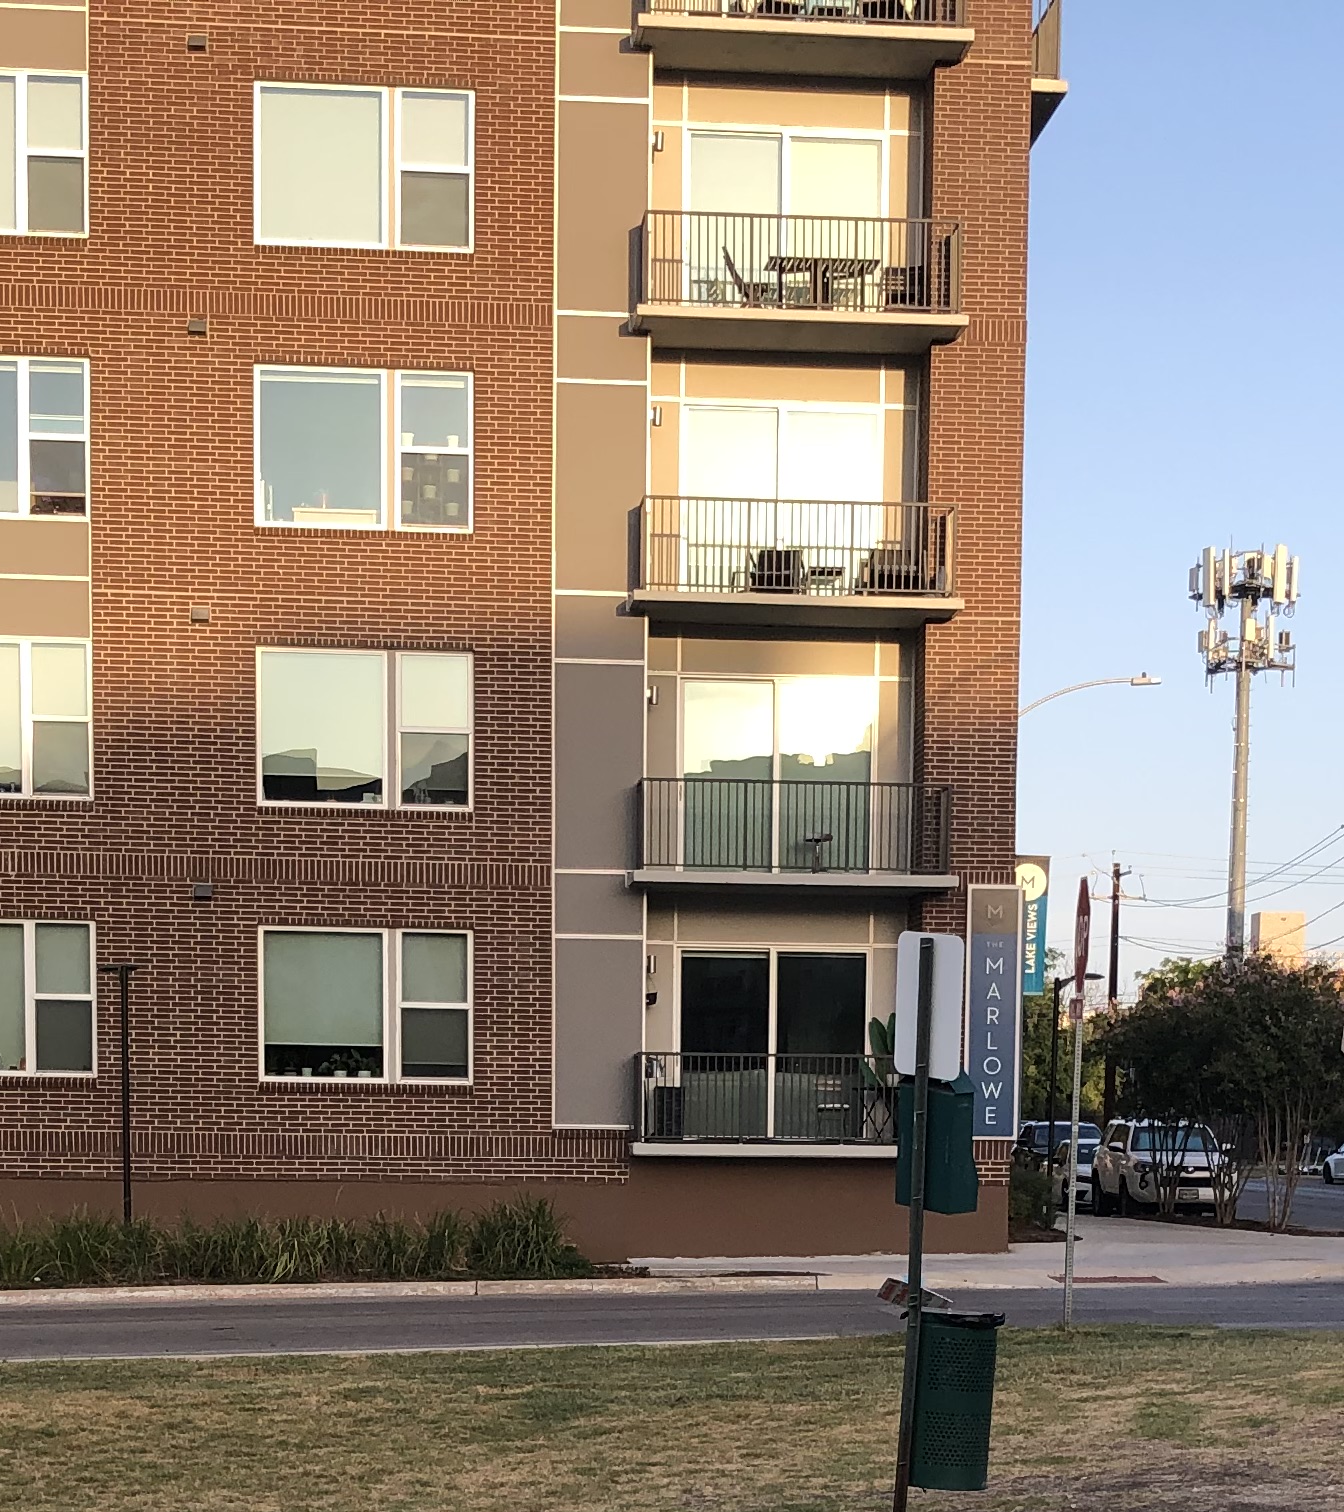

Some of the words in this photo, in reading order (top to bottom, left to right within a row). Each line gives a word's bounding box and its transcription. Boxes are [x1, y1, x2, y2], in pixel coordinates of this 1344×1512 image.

[1021, 876, 1035, 889] M
[987, 904, 1003, 919] M
[1026, 903, 1038, 941] VIEWS
[1024, 943, 1037, 974] LAKE
[981, 957, 1004, 1125] MARLOWE
